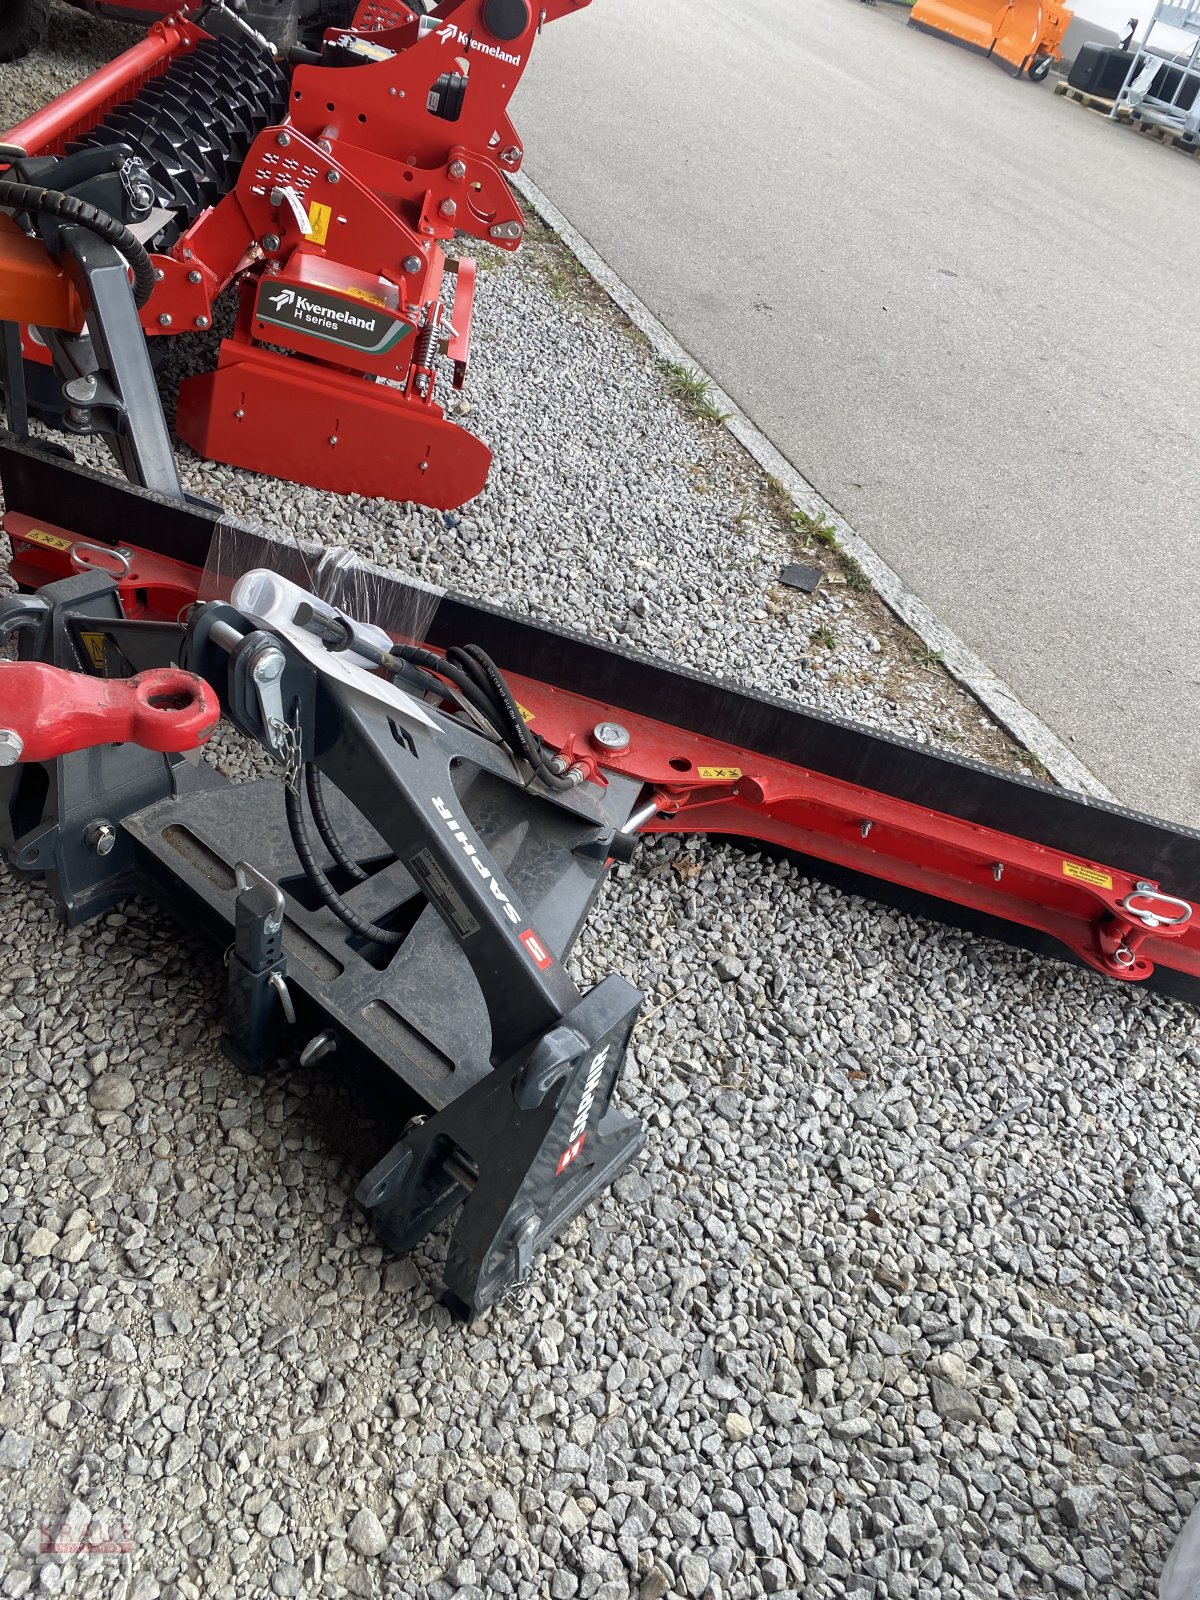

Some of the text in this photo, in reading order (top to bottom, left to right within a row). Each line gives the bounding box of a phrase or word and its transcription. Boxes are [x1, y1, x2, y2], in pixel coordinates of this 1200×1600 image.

[294, 309, 338, 330] H series
[296, 295, 376, 332] Kverneland
[515, 723, 527, 744] SAPHIR
[431, 796, 522, 924] SAPHIR
[568, 1043, 611, 1143] SAPHIR
